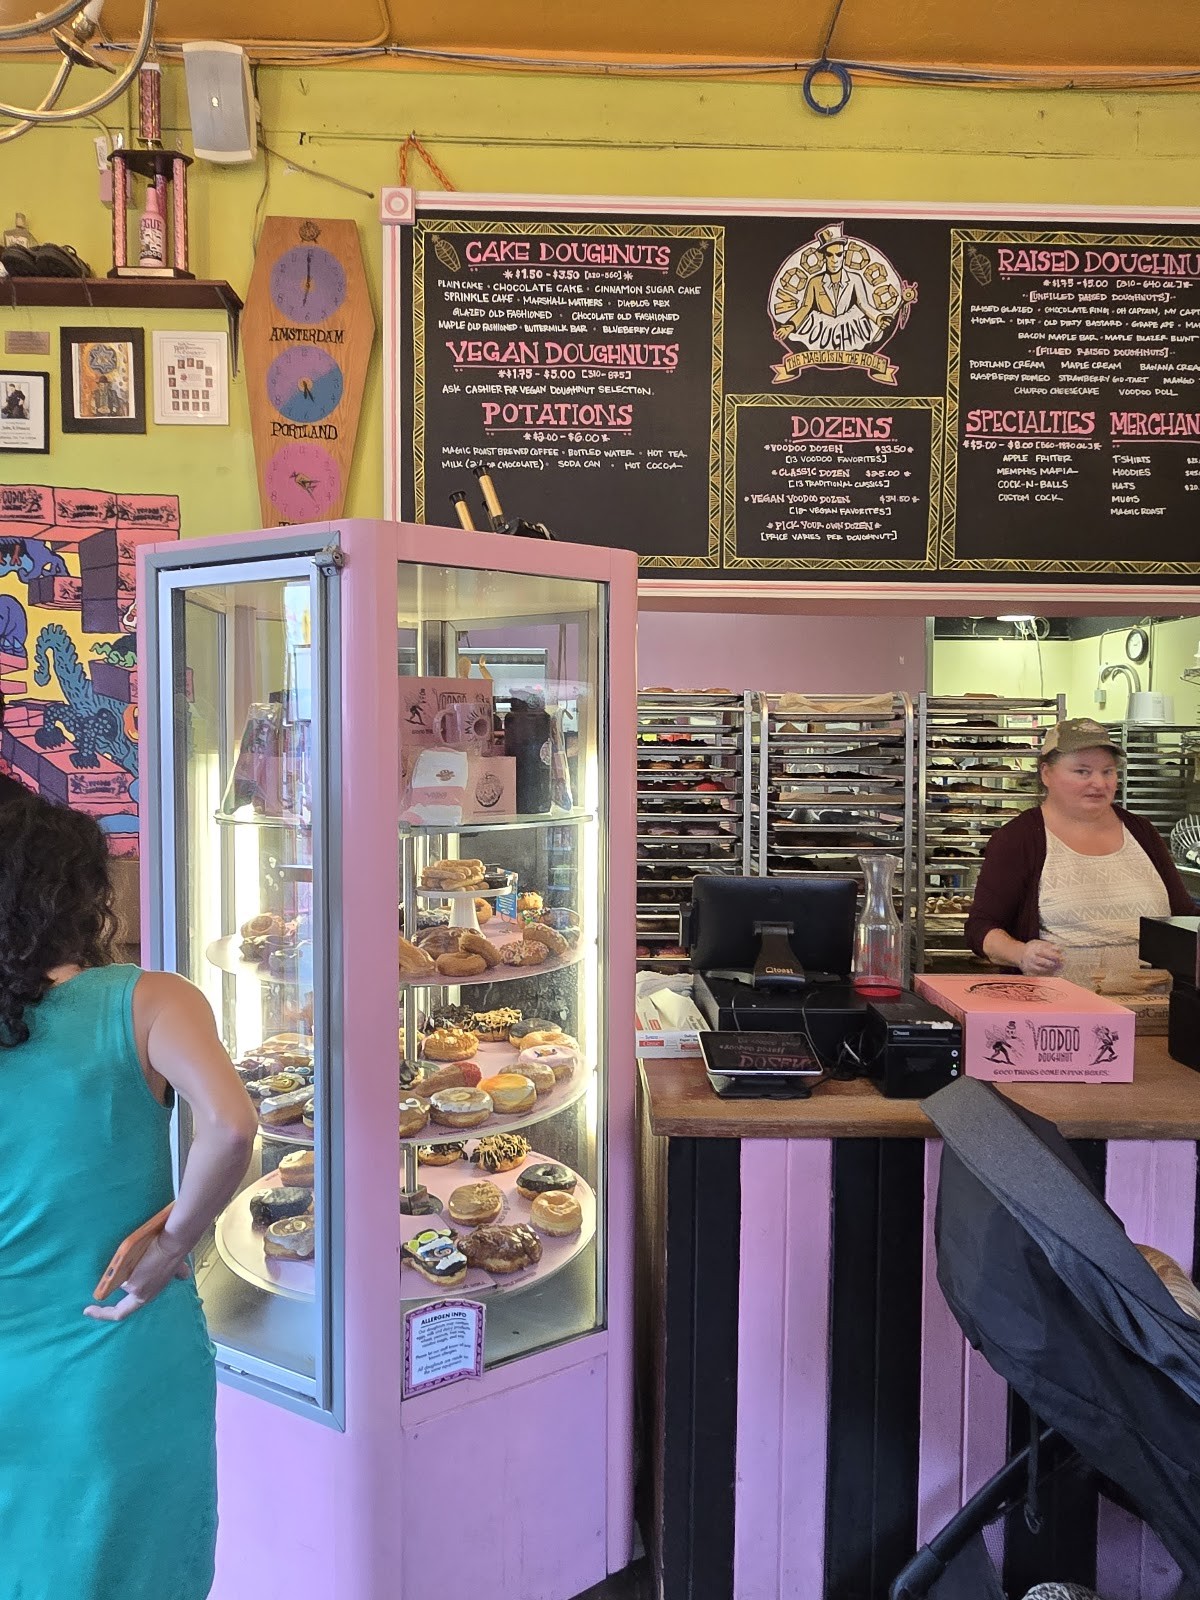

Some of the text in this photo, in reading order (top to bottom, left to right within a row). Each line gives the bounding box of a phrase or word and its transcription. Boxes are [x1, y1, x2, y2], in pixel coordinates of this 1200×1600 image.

[466, 240, 671, 266] CAKE DOUGHNUTS
[998, 249, 1080, 272] RAISED
[515, 269, 580, 280] $1.50 $3.50
[438, 280, 702, 294] PLAIN CAKE CHOCOLATE CAKE CINNAMON SUGAR CAKE
[1082, 278, 1108, 288] $5.00
[444, 292, 490, 302] SPRINKLE
[492, 294, 514, 302] CAKE
[522, 296, 567, 306] MARSHALL
[568, 298, 602, 306] MATHERS
[452, 308, 680, 322] GLAZED OLD FASHIONED CHOCOLATE OLD FASHIONED
[1000, 306, 1034, 314] GLAZED
[1044, 306, 1088, 314] CHOCOLATE
[1090, 306, 1110, 315] RING
[438, 320, 674, 335] MAPLE OLD FASHIONED BUTTERMILK BAR BLUEBERRY CAKE
[1085, 320, 1122, 328] BASTARD
[269, 327, 345, 344] AMSTERDAM
[1018, 332, 1046, 340] BACON
[1104, 334, 1133, 342] MAPLE
[446, 341, 680, 366] VEGAN DOUGHNUTS
[786, 354, 800, 369] THE
[802, 352, 826, 365] MAGIC
[827, 352, 836, 362] IS
[836, 352, 844, 362] IN
[846, 354, 860, 364] THE
[969, 360, 1012, 368] PORTLAND
[1013, 360, 1046, 369] CREAM
[1061, 361, 1090, 369] MAPLE
[1092, 362, 1122, 370] CREAM
[543, 369, 576, 380] $5.00
[970, 373, 1020, 382] RASPBERRY
[1021, 374, 1050, 382] ROMEO
[1058, 374, 1110, 383] STRAWBERRY
[442, 384, 461, 394] ASK
[465, 384, 502, 394] CASHIER
[504, 386, 518, 394] FOR
[520, 385, 546, 394] VEGAN
[550, 386, 596, 396] DOUGHNUT
[1050, 387, 1100, 395] CHEESECAKE
[1154, 388, 1178, 396] DOLL
[482, 402, 633, 426] POTATIONS
[791, 416, 892, 438] DOZENS
[966, 410, 1096, 434] SPECIALTIES
[270, 422, 338, 440] PORTLAND
[568, 432, 600, 442] $6.00
[442, 446, 472, 454] MAGIC
[473, 447, 498, 456] ROAST
[498, 448, 528, 456] BREWED
[530, 448, 559, 456] COFFEE
[568, 448, 602, 456] BOTTLED
[604, 450, 634, 458] WATER
[647, 450, 664, 458] HOT
[770, 444, 806, 452] VOODOO
[809, 444, 844, 454] DOZEN
[1002, 454, 1072, 462] APPLE FRITTER
[1112, 454, 1152, 464] T-SHIRTS
[442, 459, 683, 470] MILK CHOCOLATE) SODA CAN HOT COCOA
[778, 468, 817, 476] CLASSIC
[819, 468, 850, 478] DOZEN
[996, 466, 1079, 476] MEMPHIS MAFIA
[1112, 468, 1152, 476] HOODIES
[804, 480, 853, 488] TRADITIONAL
[998, 480, 1068, 489] COCK-N-BALLS
[1112, 482, 1136, 490] HATS
[750, 494, 850, 504] VEGAN VOODOO DOZEN
[998, 494, 1064, 502] CUSTOM COCK
[1112, 495, 1140, 503] MUGS
[809, 506, 838, 514] VEGAN
[1110, 508, 1140, 516] MAGIC
[774, 520, 874, 530] PICK YOUR OWN DOZEN
[1025, 1020, 1080, 1052] VOODOO
[1038, 1052, 1073, 1062] DOUGHNUT
[420, 1312, 450, 1326] ALLERGEN
